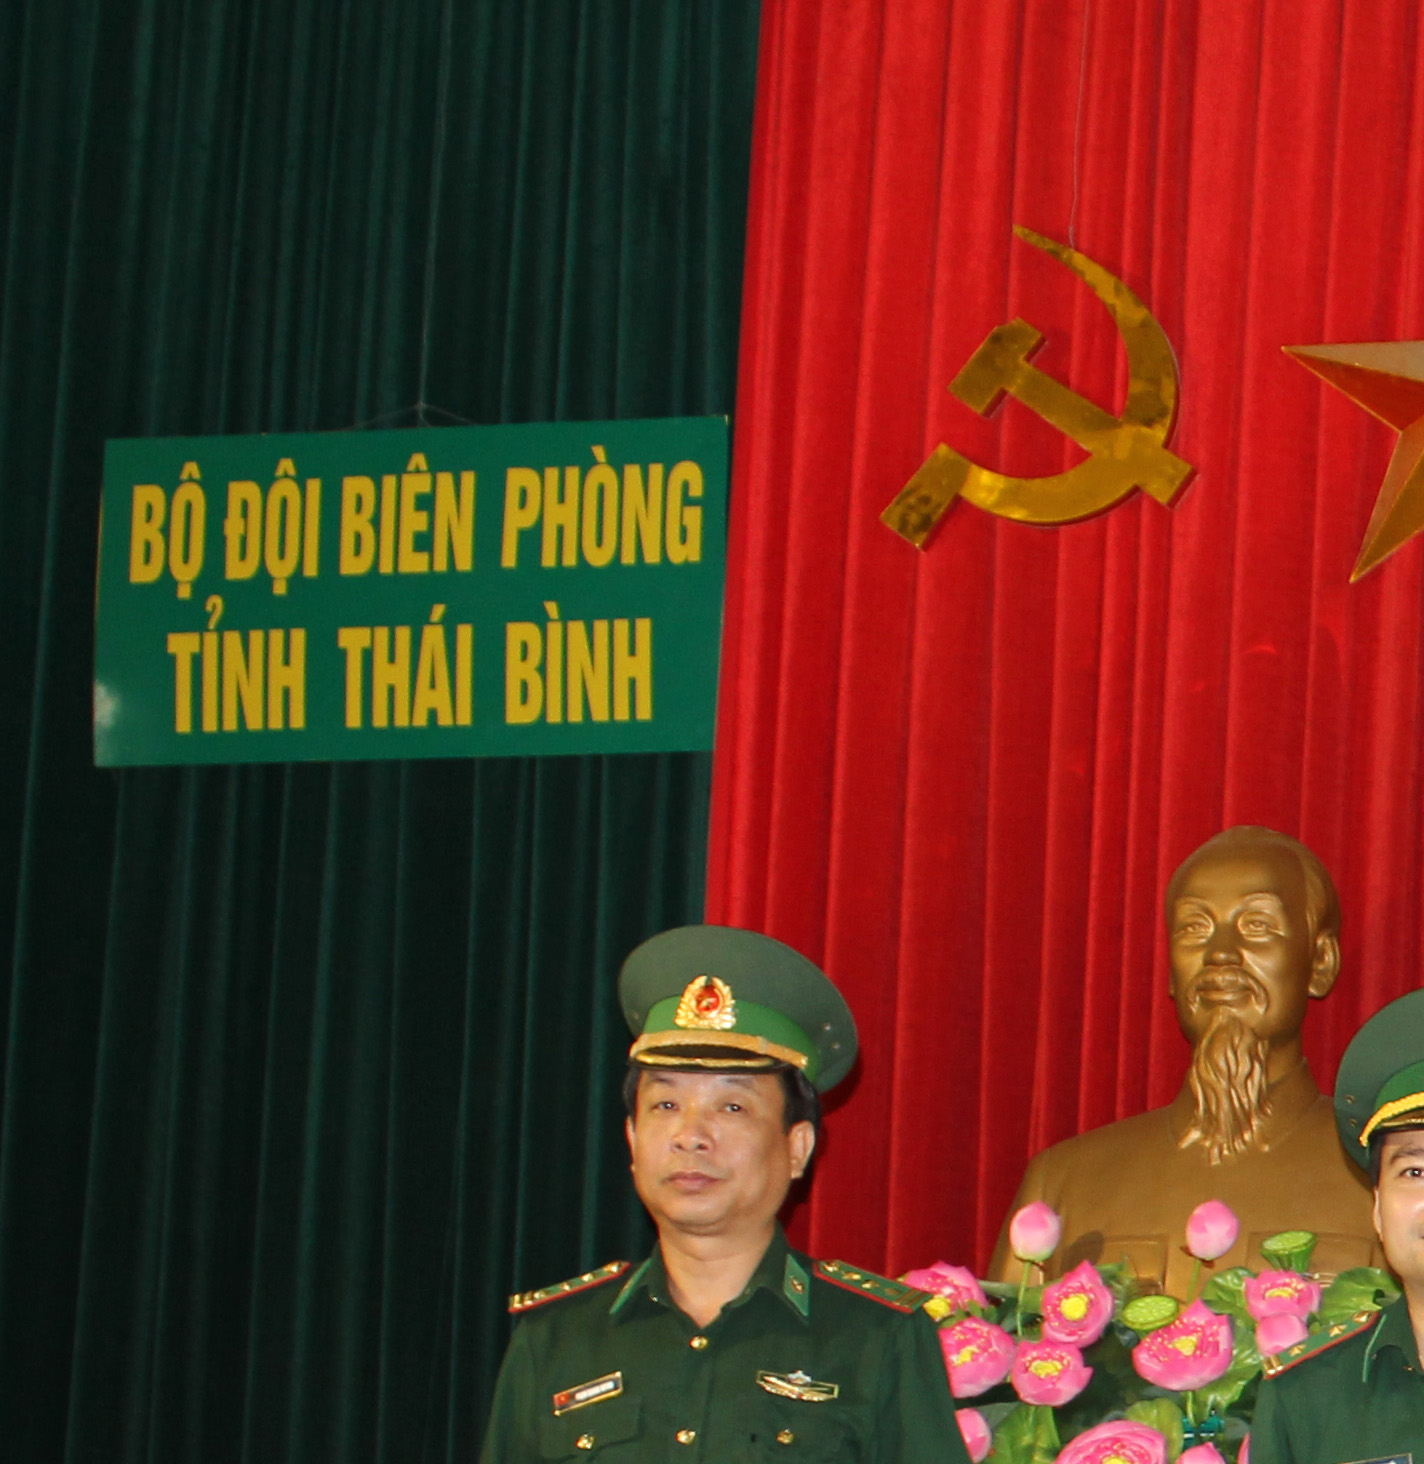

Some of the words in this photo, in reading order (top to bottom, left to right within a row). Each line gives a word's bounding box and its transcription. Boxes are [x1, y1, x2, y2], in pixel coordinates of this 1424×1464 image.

[129, 462, 206, 598] BỘ
[223, 458, 321, 595] ĐỘI
[339, 453, 476, 575] BIÊN
[501, 445, 703, 568] PHÒNG
[167, 595, 306, 732] TỈNH
[338, 604, 473, 728] THÁI
[504, 601, 652, 724] BÌNH
